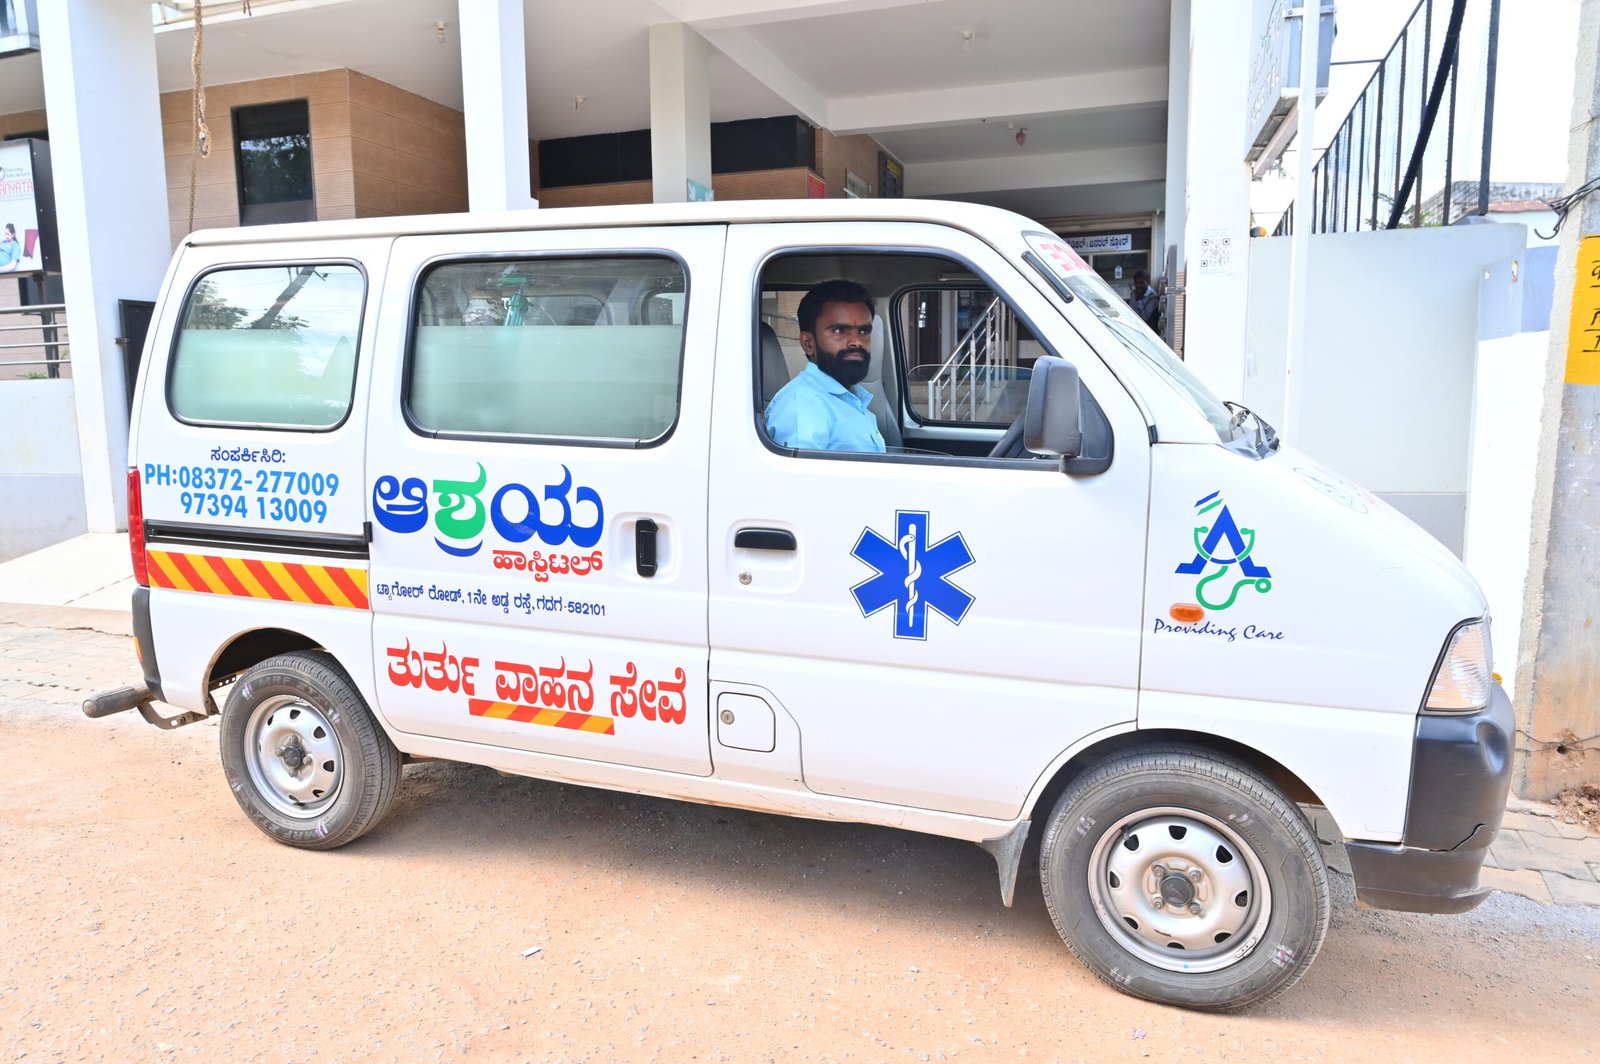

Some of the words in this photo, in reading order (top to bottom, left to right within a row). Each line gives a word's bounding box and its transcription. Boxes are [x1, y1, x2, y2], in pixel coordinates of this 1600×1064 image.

[210, 446, 286, 463] ಸಂಪರ್ಕಿಸಿರಿ:
[145, 463, 339, 497] PH:08372-277009
[180, 492, 248, 518] 97394
[257, 497, 327, 524] 13009
[372, 462, 604, 557] ಆಶ್ರಯ
[492, 549, 603, 583] ಹಾಸ್ಪಿಟಲ್
[491, 592, 509, 613] ಅಡ್ಡ
[1153, 617, 1238, 642] Providing
[1243, 624, 1285, 640] Care
[387, 637, 479, 696] ತುರ್ತು
[494, 655, 594, 712] ವಾಹನ
[609, 661, 686, 725] ಸೇವೆ
